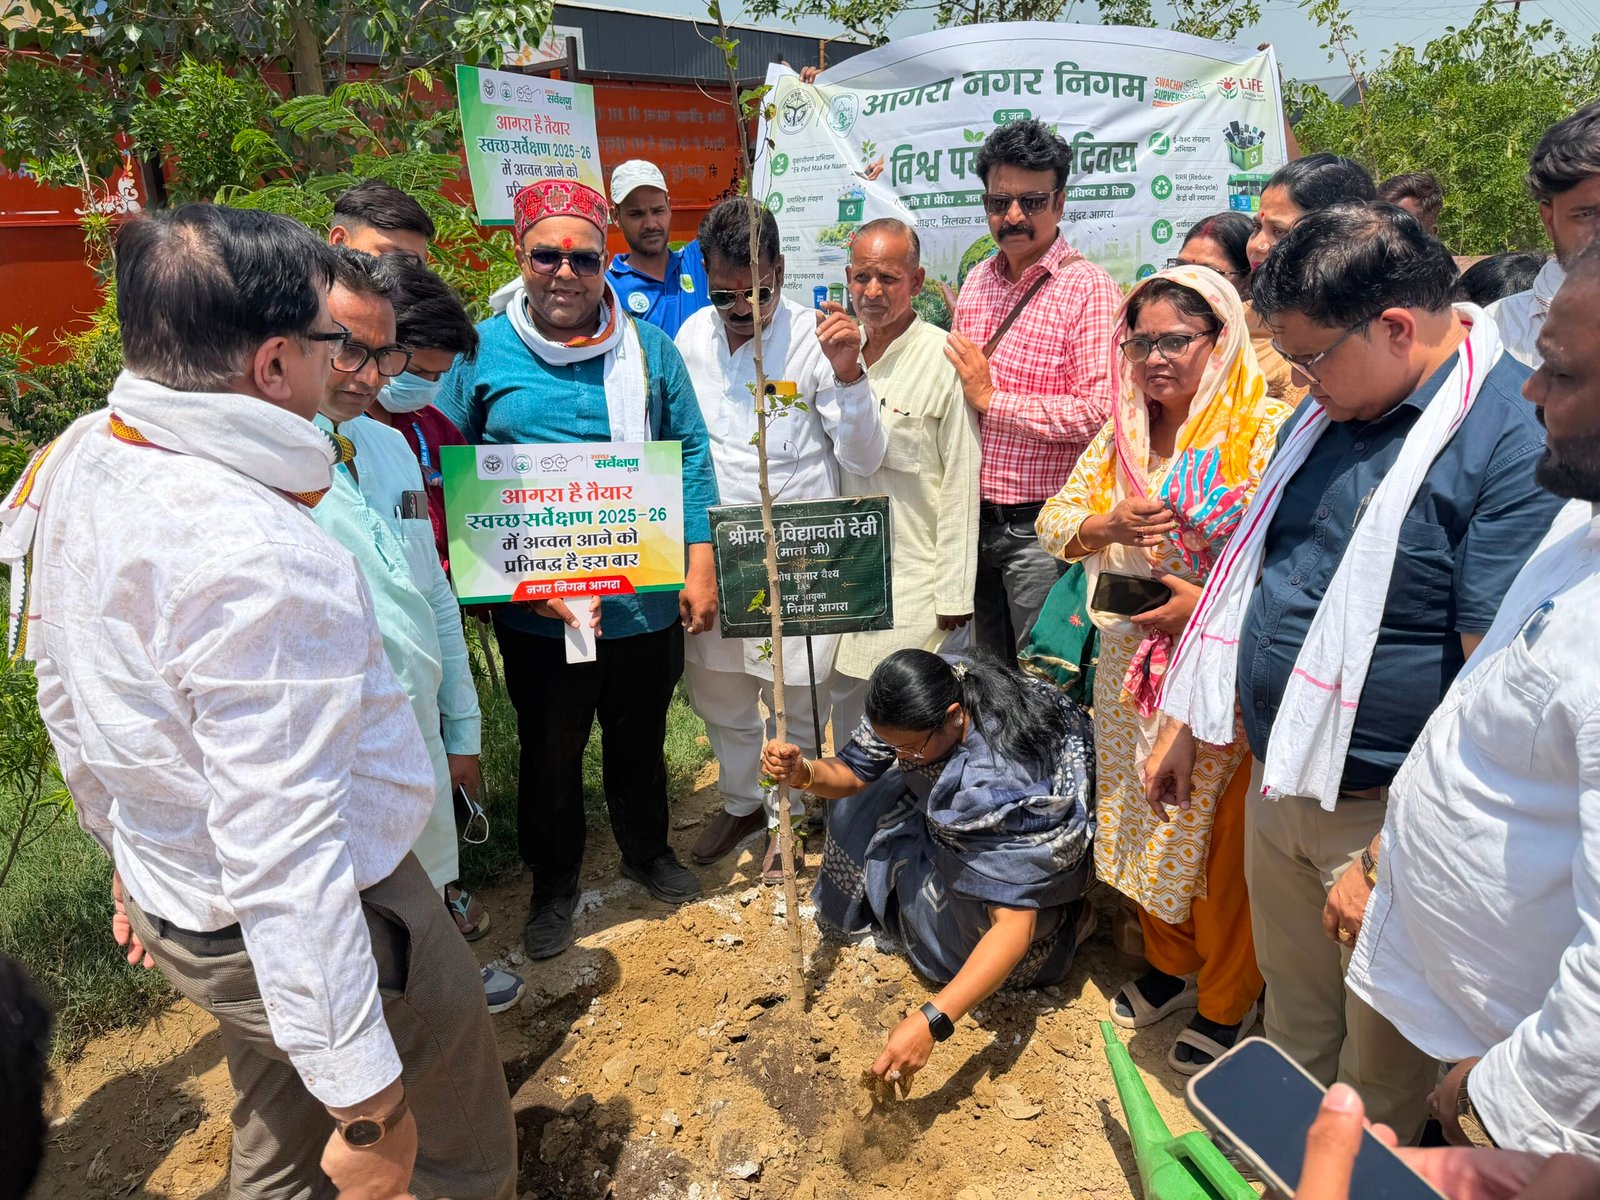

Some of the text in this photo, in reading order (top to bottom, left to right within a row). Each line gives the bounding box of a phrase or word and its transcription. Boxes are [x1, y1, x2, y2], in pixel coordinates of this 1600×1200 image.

[862, 61, 1147, 116] आगरा नगर निगम
[1155, 76, 1183, 91] SWACHH
[1239, 78, 1264, 92] LiFE
[496, 114, 570, 135] आगरा है तैयार
[1000, 112, 1006, 121] 5
[478, 138, 510, 153] स्वच्छ
[510, 136, 551, 156] सर्वेक्षण
[553, 143, 591, 159] 2025-26
[501, 159, 579, 178] में अव्वल आने को
[890, 144, 941, 187] विश्व
[923, 195, 930, 205] से
[934, 194, 954, 204] प्रेरित
[1067, 185, 1129, 198] भविष्य के लिए
[942, 215, 972, 226] मिलकर
[1089, 210, 1113, 219] आगरा
[594, 455, 639, 468] सर्वेक्षण
[502, 480, 633, 504] आगरा है तैयार
[467, 507, 667, 529] स्वच्छ सर्वेक्षण 2025-26
[780, 518, 845, 543] विद्यावती
[849, 515, 878, 537] देवी
[502, 527, 638, 550] में अव्वल आने को
[775, 542, 830, 560] (माता जी)
[504, 552, 639, 574] प्रतिबद्ध है इस बार
[793, 571, 818, 584] कुमार
[821, 569, 839, 580] वैश्य
[526, 579, 620, 595] नगर निगम आगरा
[782, 594, 799, 602] नगर
[787, 602, 815, 614] निगम
[819, 601, 848, 613] आगरा
